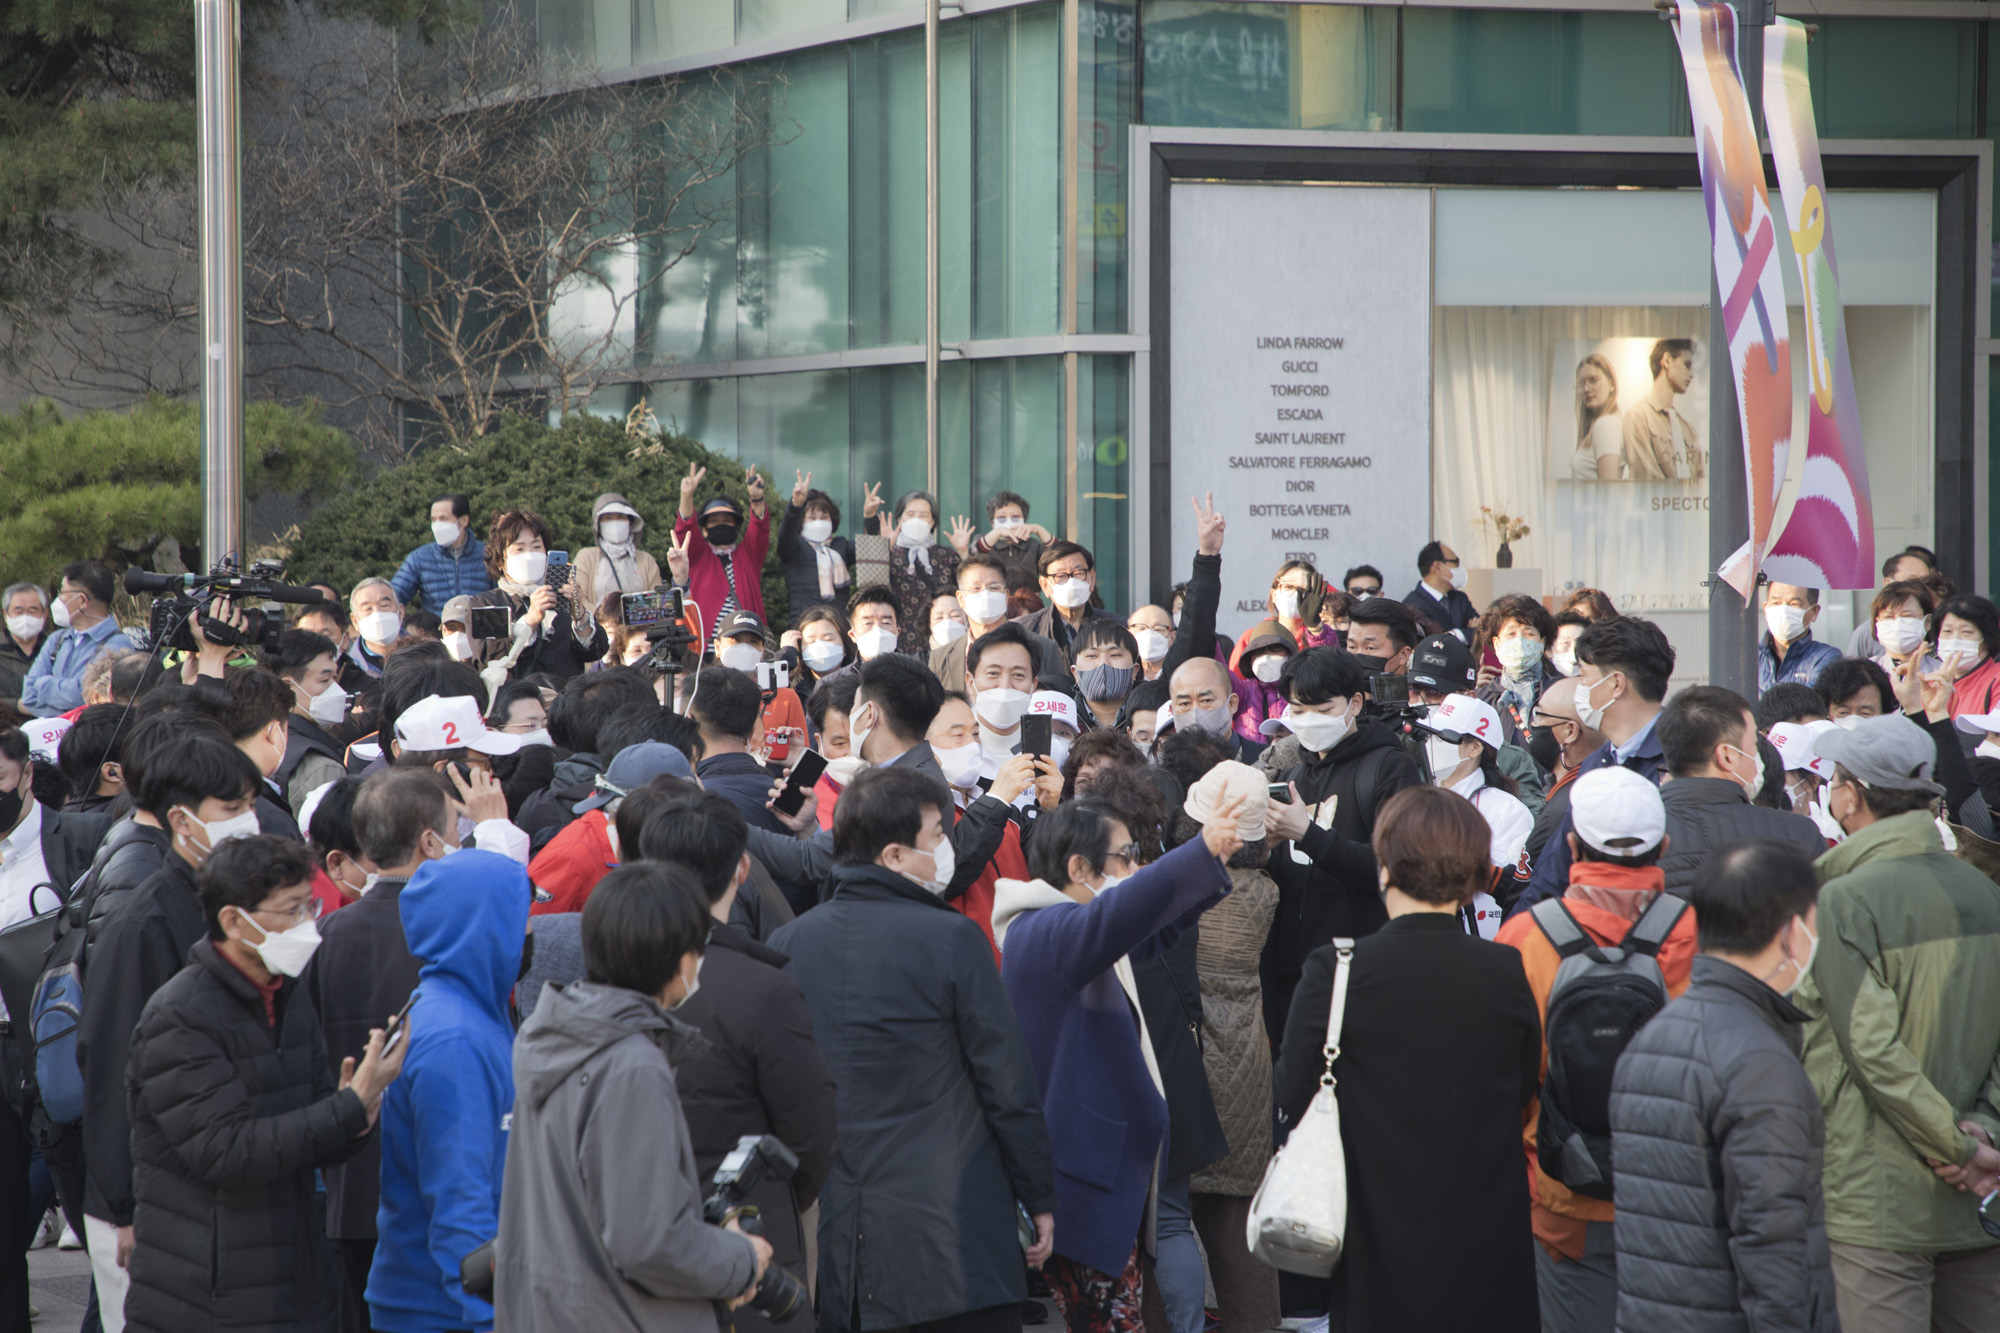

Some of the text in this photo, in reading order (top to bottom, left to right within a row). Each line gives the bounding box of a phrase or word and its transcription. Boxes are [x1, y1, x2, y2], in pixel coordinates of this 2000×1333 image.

[1256, 337, 1344, 350] LINDA FARROW
[1282, 361, 1318, 373] GUCCI
[1270, 384, 1330, 397] TOMFORD
[1277, 408, 1323, 421] ESCADA
[1255, 432, 1346, 445] SAINT LAURENT
[1229, 456, 1372, 469] SALVATORE FERRAGAMO
[1285, 480, 1315, 493] DIOR
[1249, 504, 1351, 517] BOTTEGA VENETA
[1271, 528, 1329, 541] MONCLER
[1034, 700, 1068, 715] 오세훈
[442, 722, 460, 745] 2
[1475, 717, 1490, 738] 2
